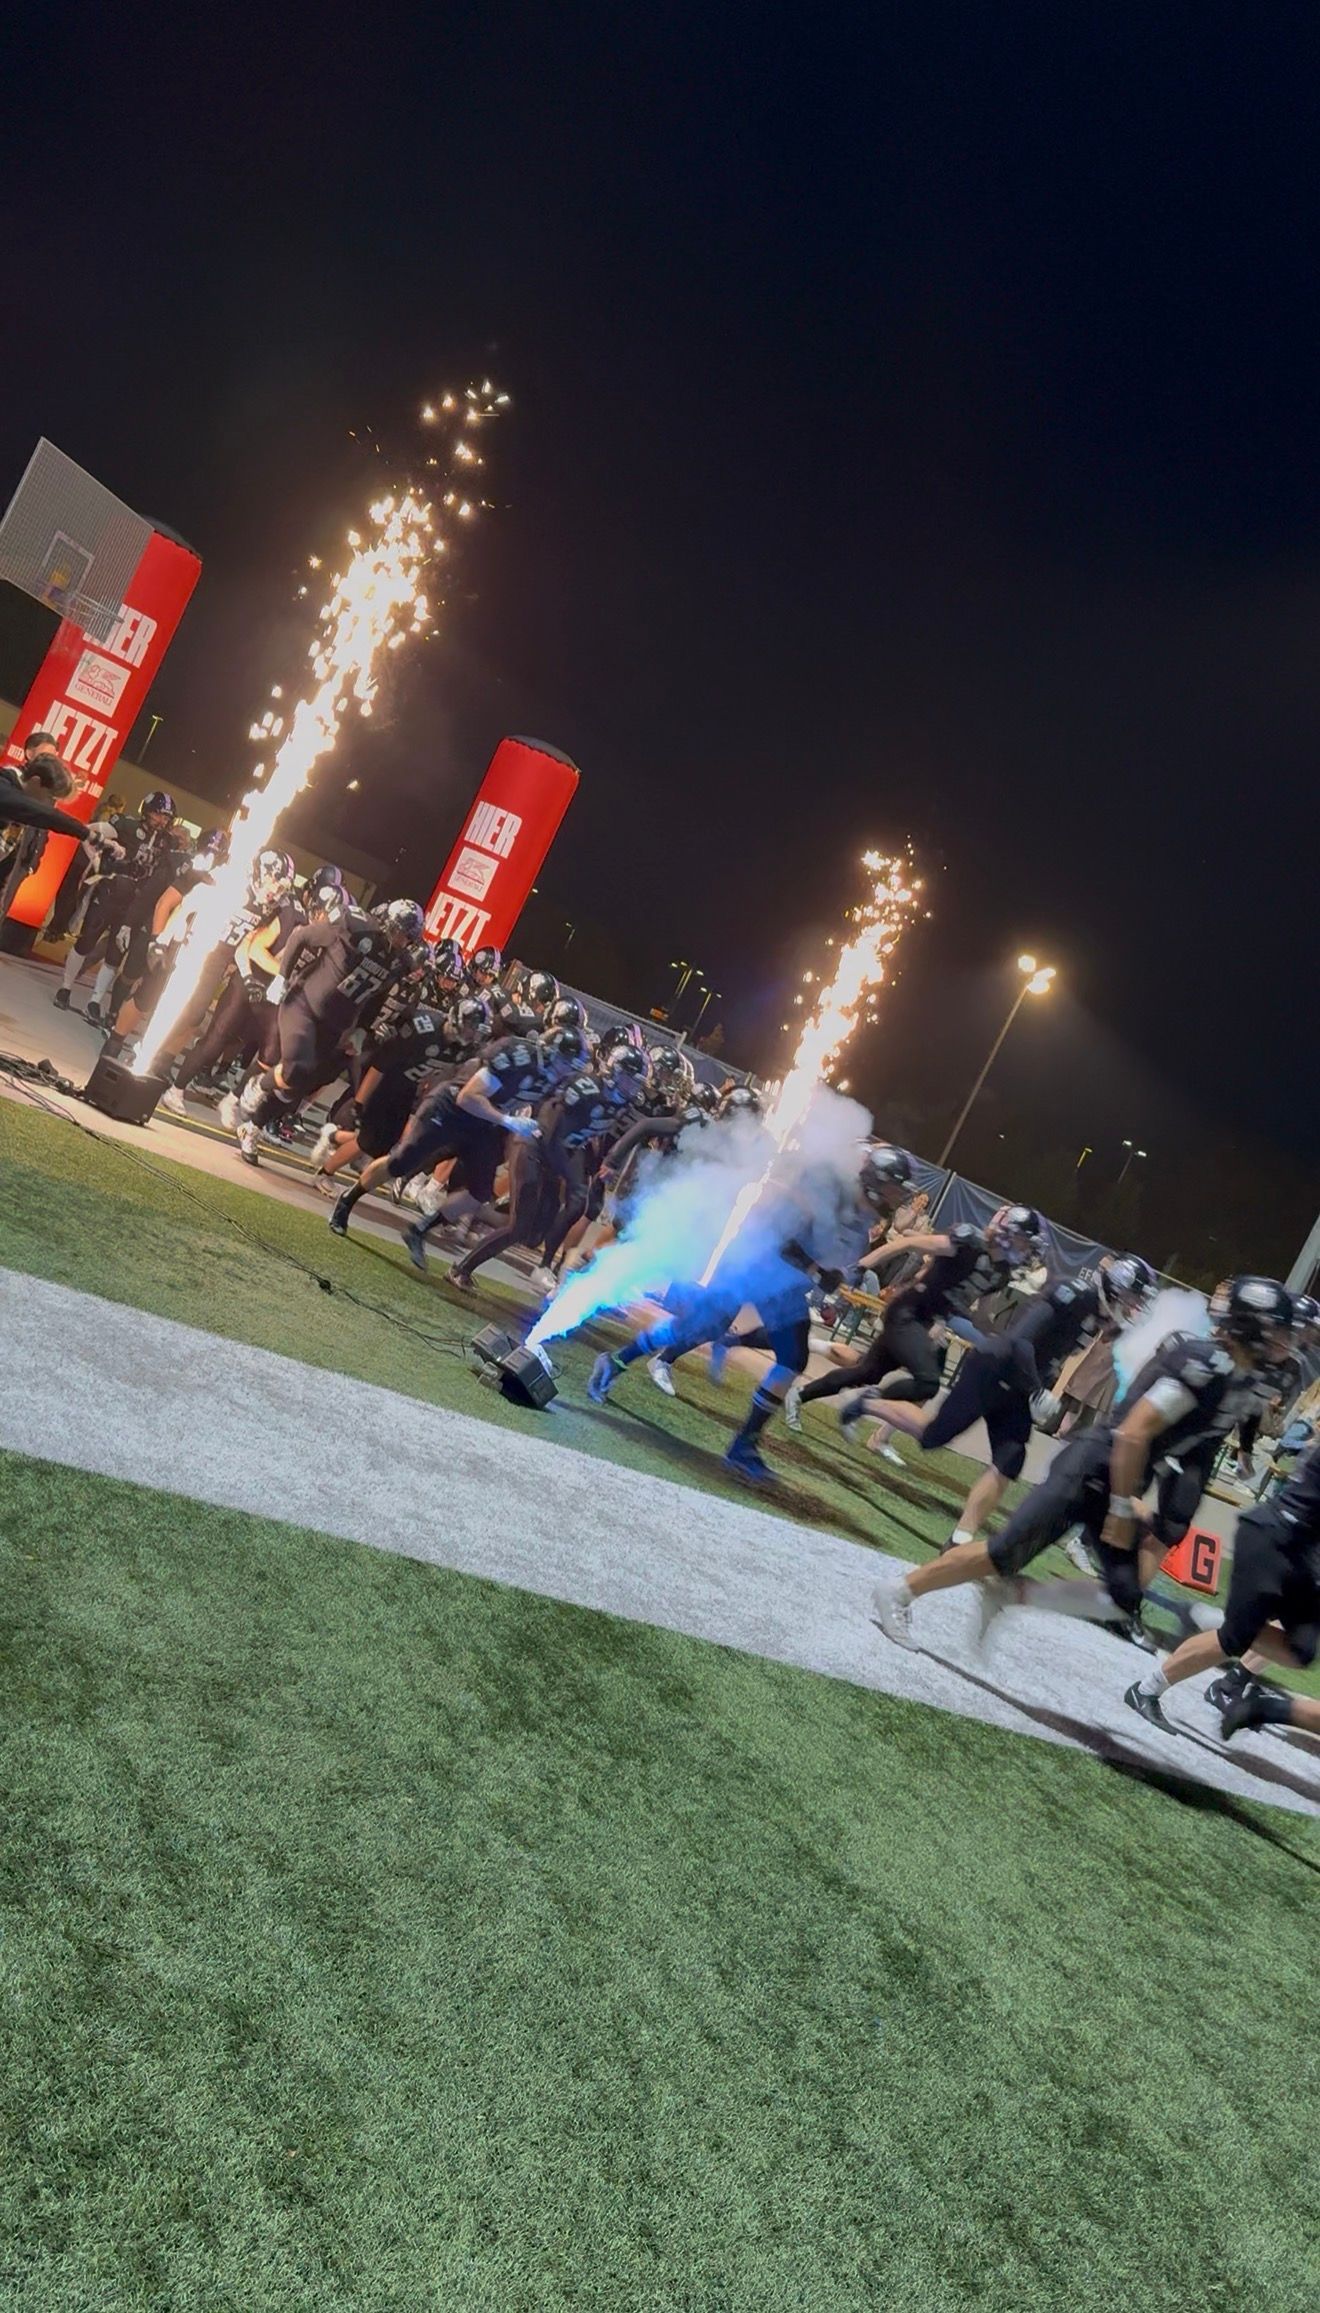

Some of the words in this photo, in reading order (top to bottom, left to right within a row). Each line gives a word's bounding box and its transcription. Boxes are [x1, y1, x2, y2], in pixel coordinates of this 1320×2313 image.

[464, 801, 523, 859] HIER
[425, 891, 492, 952] JETZT
[337, 966, 382, 1004] 67
[413, 1015, 435, 1035] 29
[575, 1076, 600, 1096] 27
[1079, 1267, 1094, 1281] EF
[1191, 1534, 1216, 1585] G
